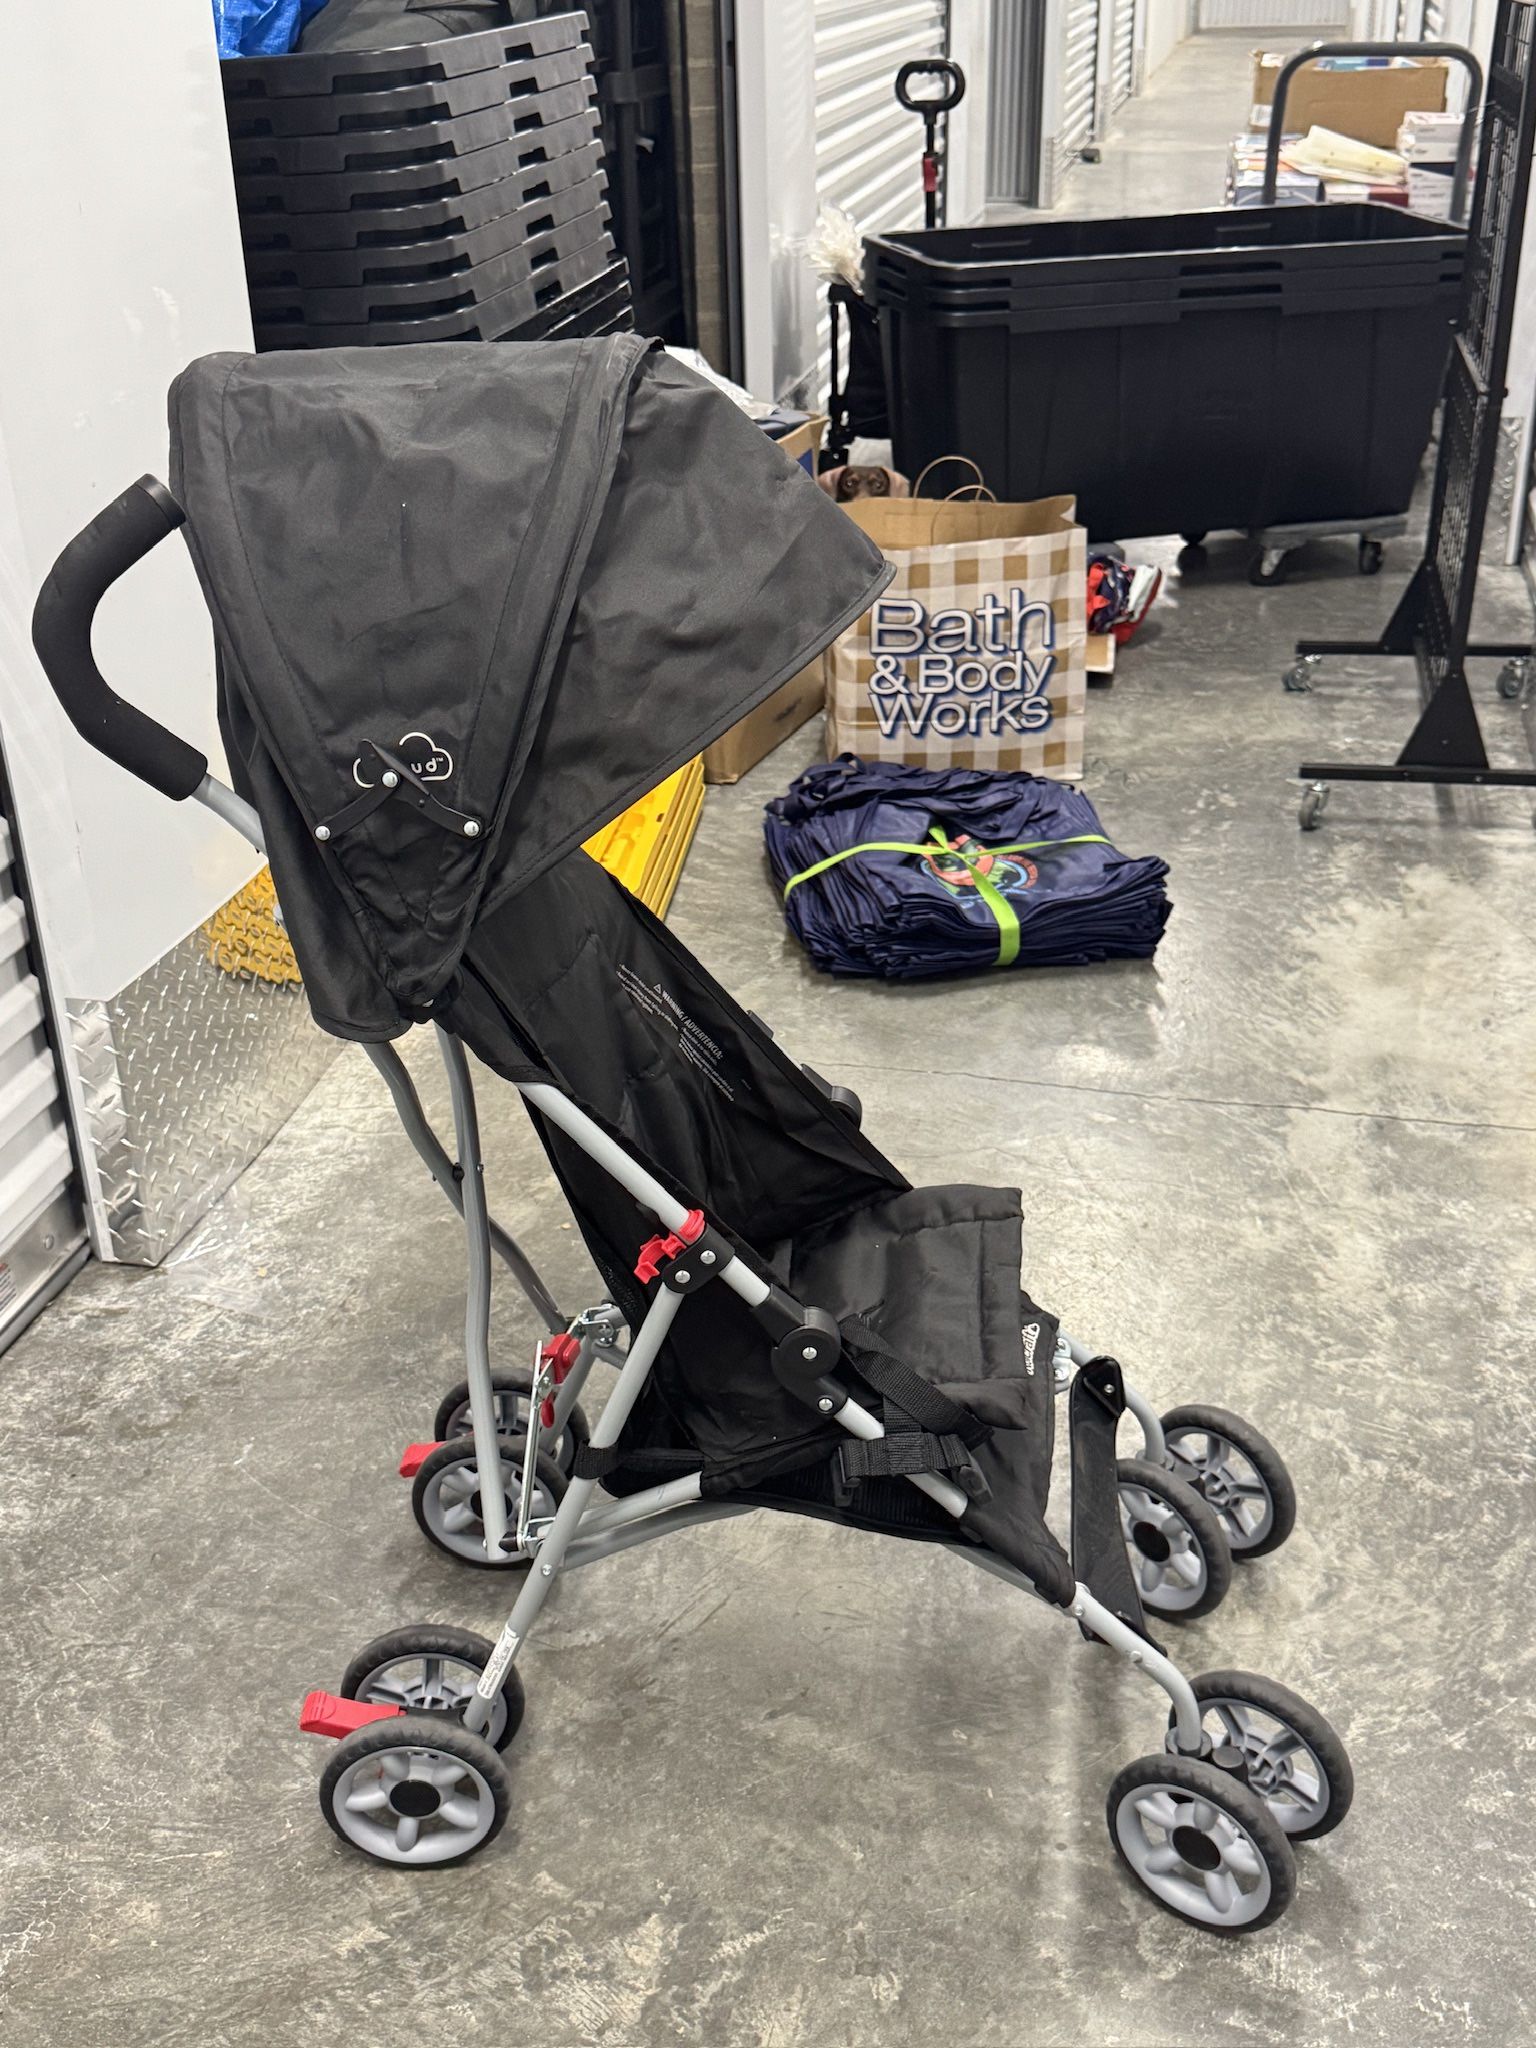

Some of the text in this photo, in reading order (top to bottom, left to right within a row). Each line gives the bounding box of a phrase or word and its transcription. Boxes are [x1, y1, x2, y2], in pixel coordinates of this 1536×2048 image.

[870, 587, 1055, 656] Bath
[869, 649, 1055, 699] & Body
[868, 690, 1054, 738] Works
